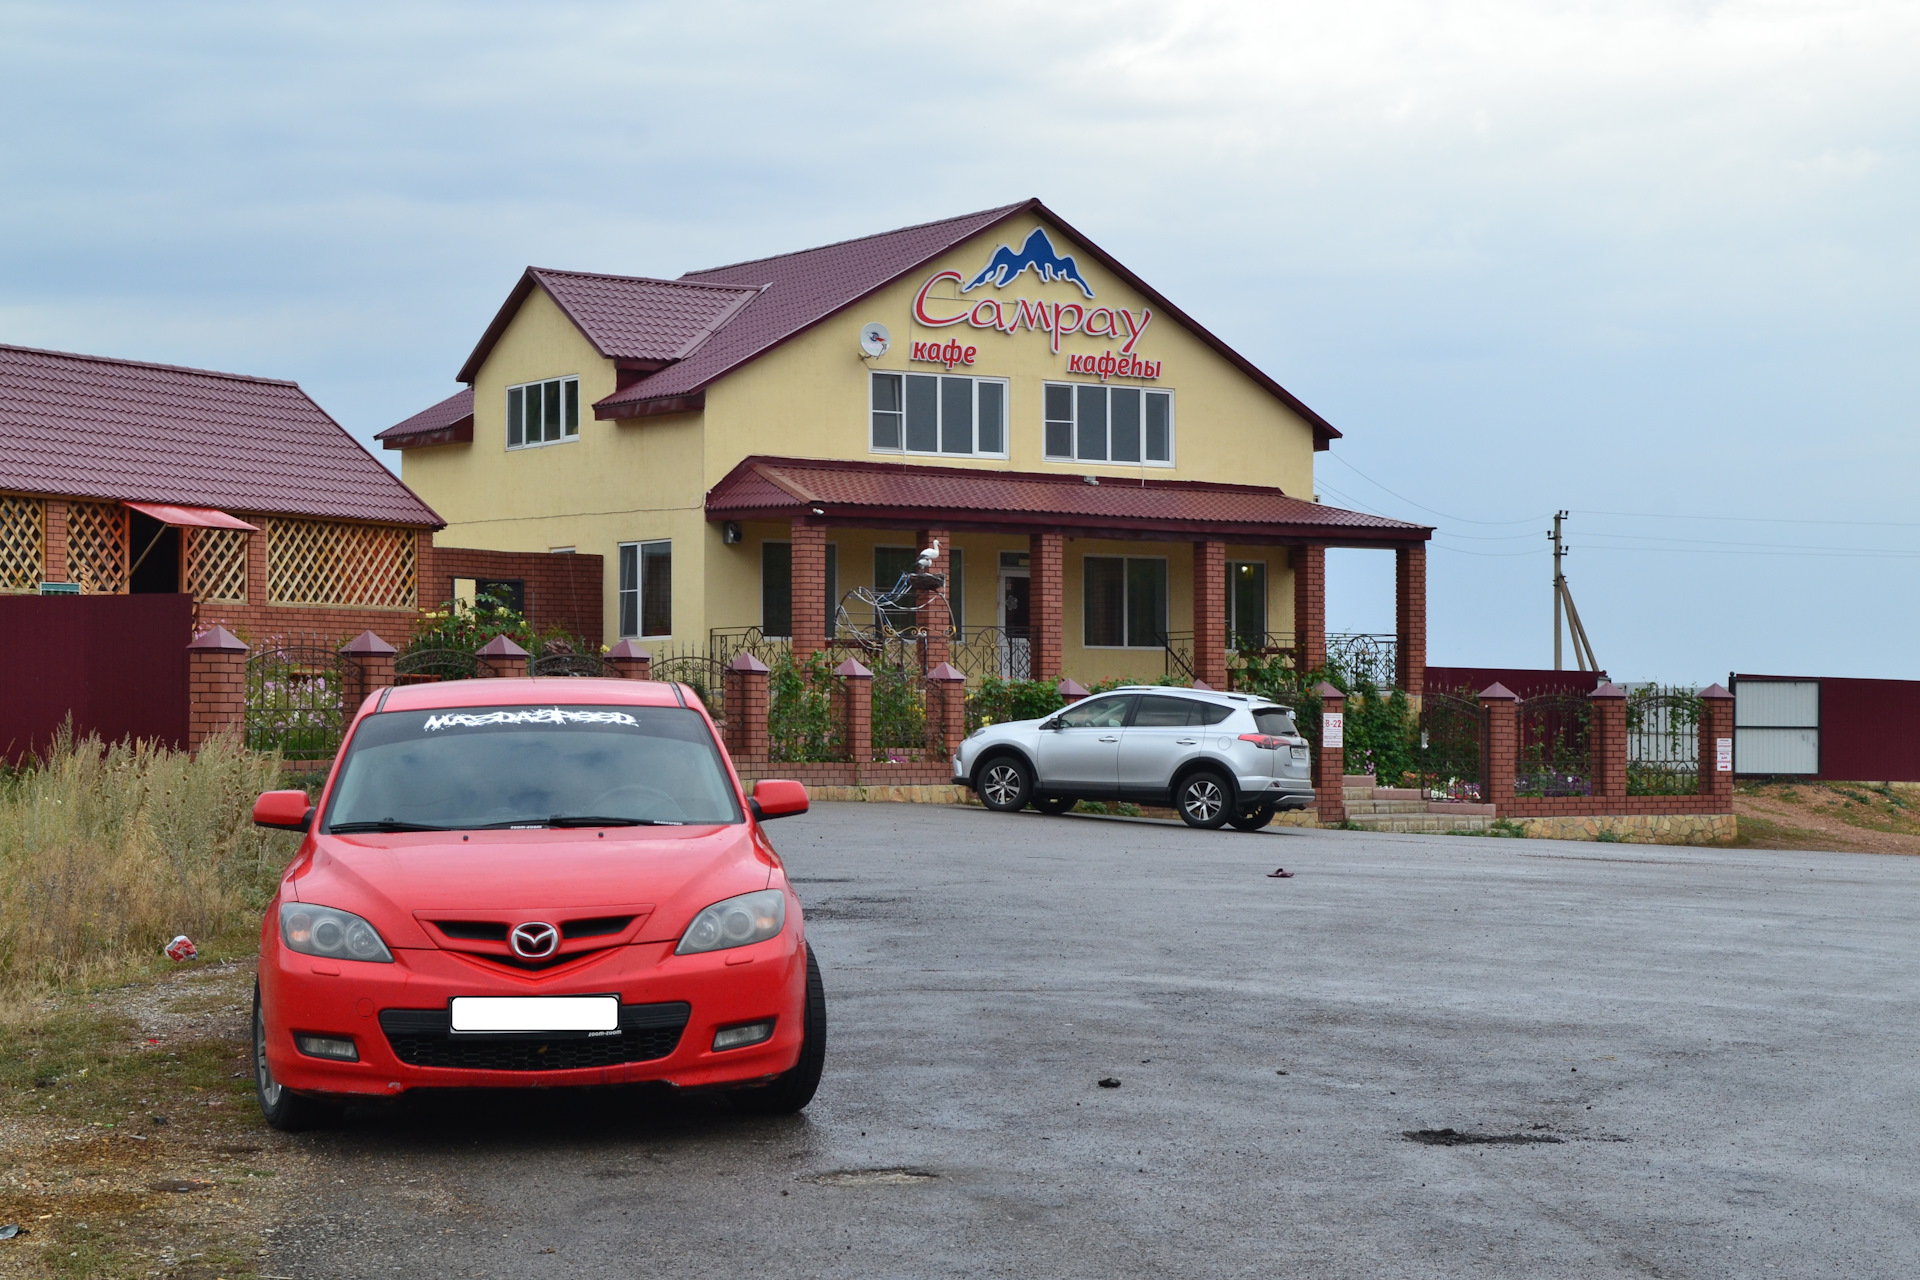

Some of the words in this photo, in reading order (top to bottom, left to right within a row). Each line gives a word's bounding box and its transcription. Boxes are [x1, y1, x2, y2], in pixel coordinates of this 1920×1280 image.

[912, 270, 1152, 354] Самрау
[911, 338, 977, 368] кафе
[1068, 350, 1162, 380] кафеһы
